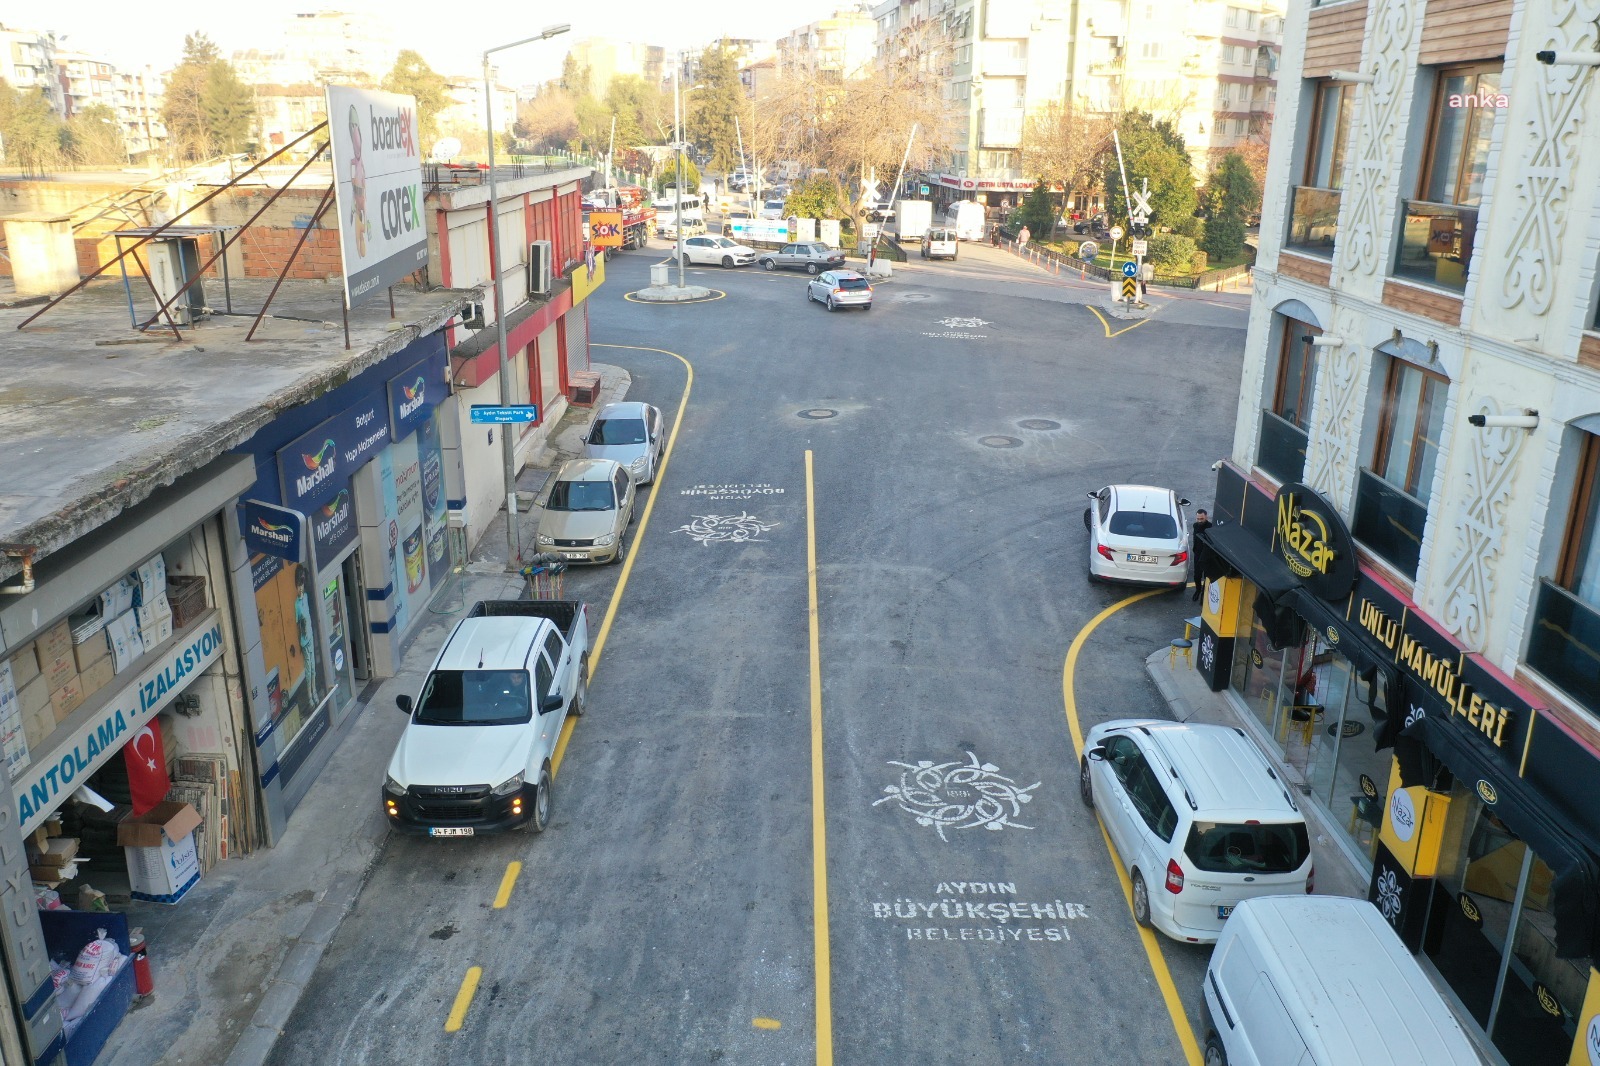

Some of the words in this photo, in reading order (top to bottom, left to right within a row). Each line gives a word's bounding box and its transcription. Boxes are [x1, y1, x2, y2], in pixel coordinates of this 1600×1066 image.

[370, 104, 415, 157] boardex
[380, 184, 420, 241] corex
[400, 391, 424, 420] Marshall
[296, 457, 335, 498] Marshall
[251, 525, 289, 543] Marshall
[317, 503, 348, 541] Marshall
[1277, 492, 1334, 575] Nazar
[1359, 597, 1397, 650] UNLU
[20, 709, 127, 827] ANTOLAMA
[139, 623, 223, 713] İZALASYON
[1391, 796, 1414, 829] Nazar
[0, 771, 42, 986] OLYURT
[936, 882, 1017, 894] AYDIN
[872, 898, 1089, 923] BÜYÜKŞEHİR
[1460, 896, 1480, 922] Nazar
[906, 925, 1071, 942] BELEDİYESİ
[1537, 985, 1561, 1017] Nazar
